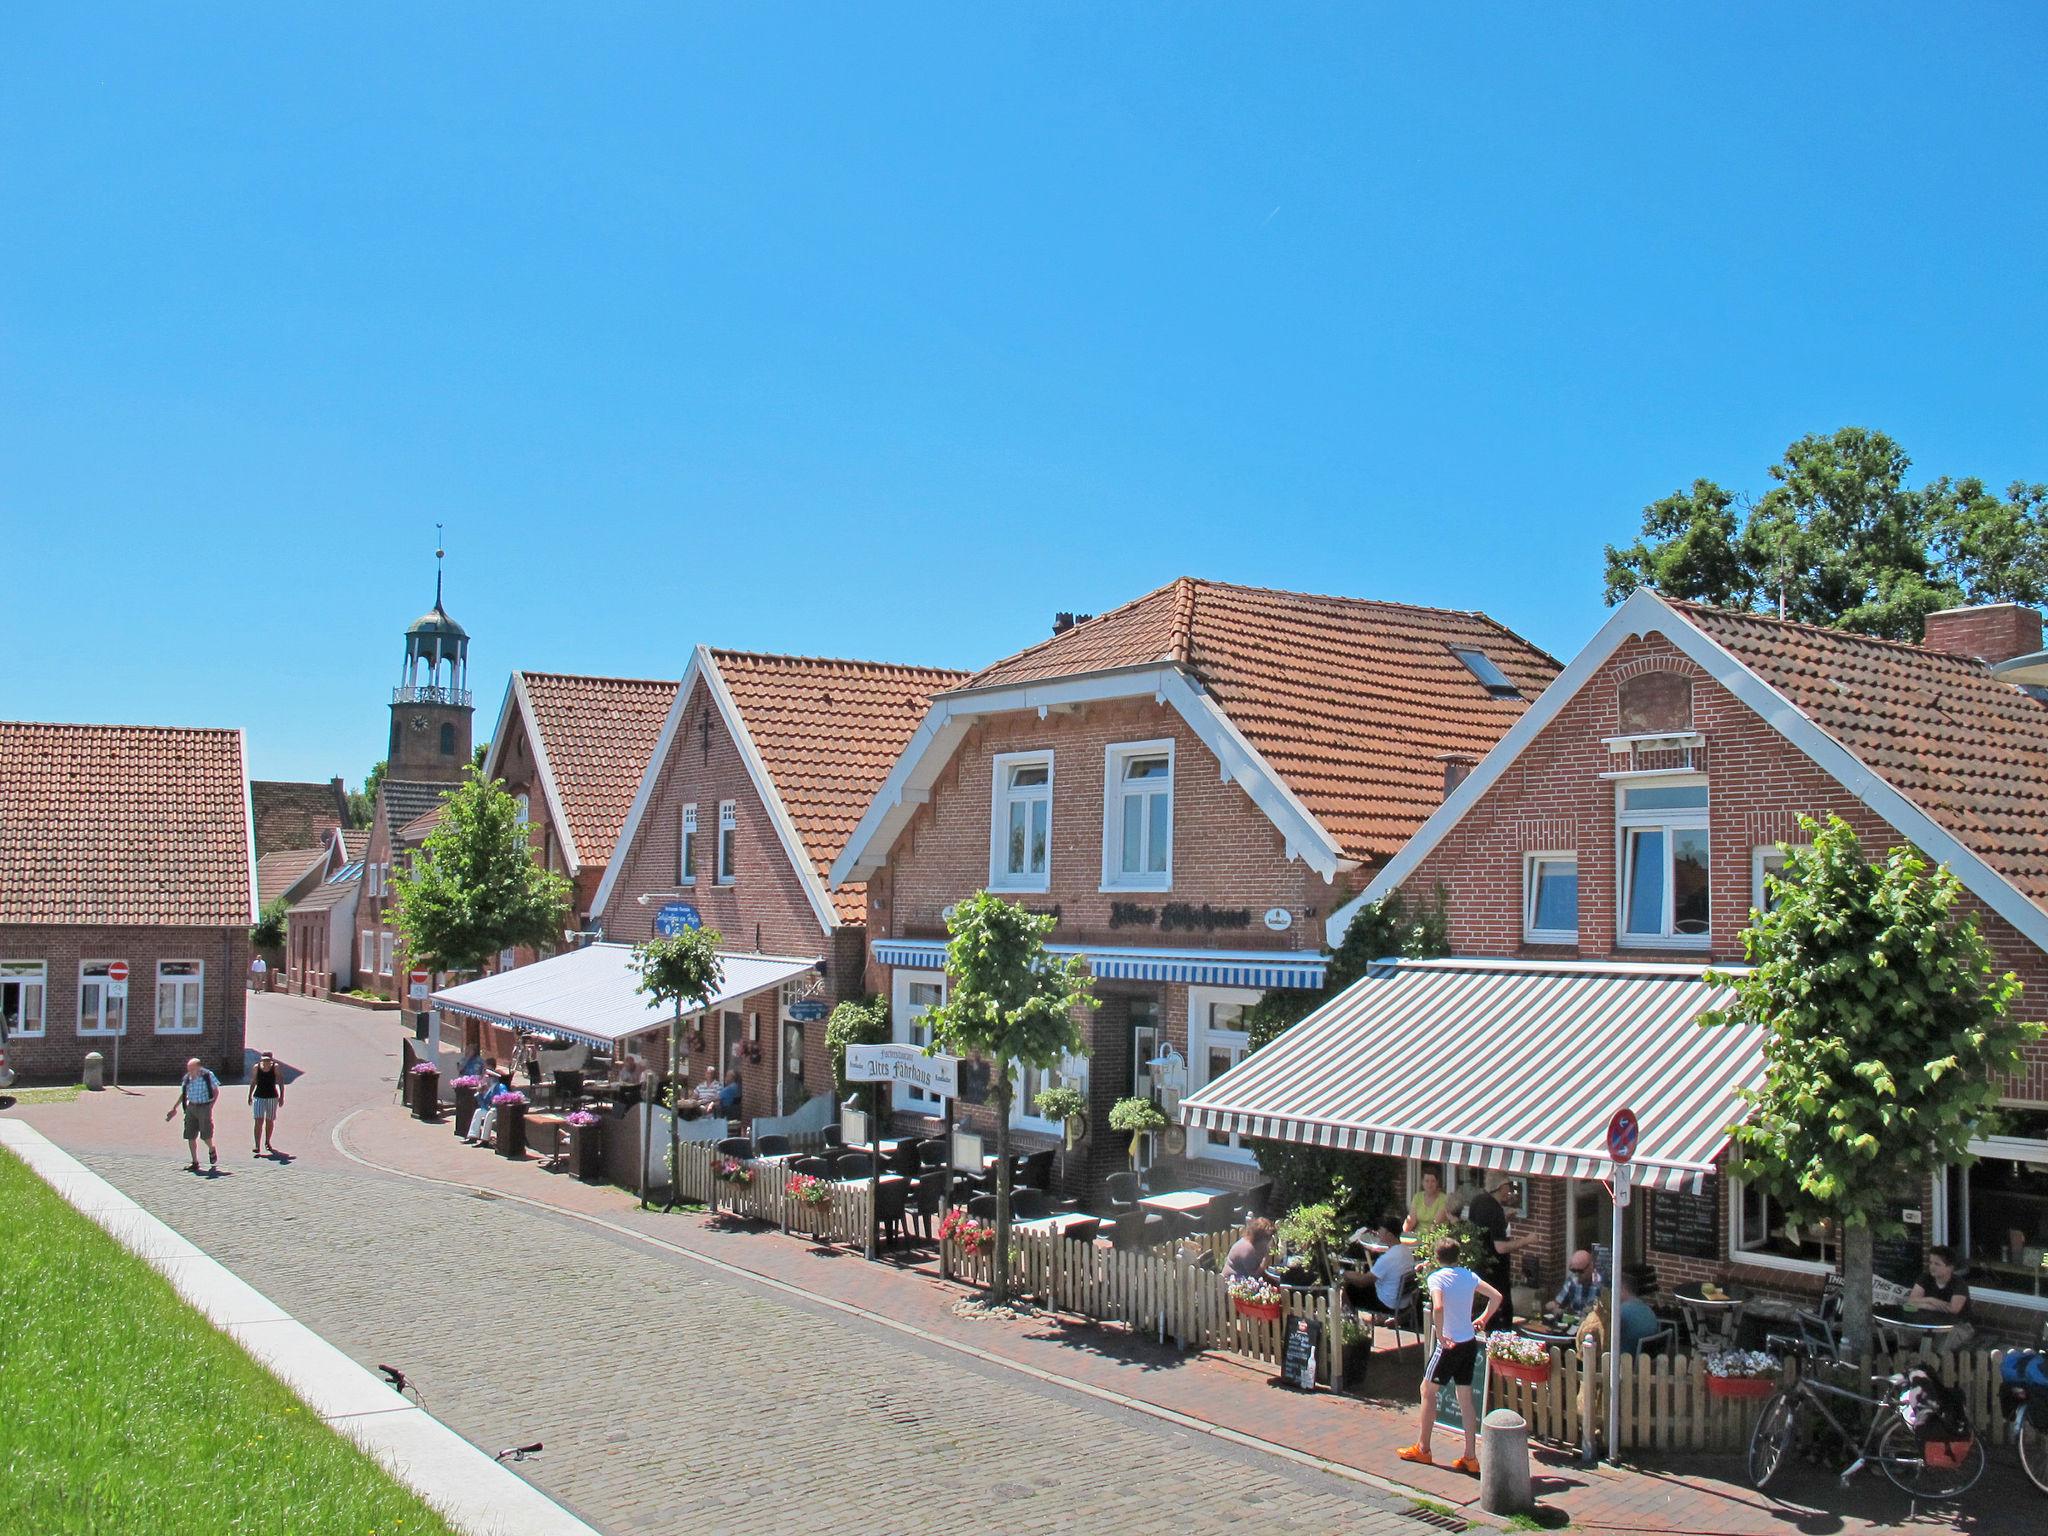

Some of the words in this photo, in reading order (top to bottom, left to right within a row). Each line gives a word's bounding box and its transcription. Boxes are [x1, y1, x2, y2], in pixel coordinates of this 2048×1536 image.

[867, 1060, 890, 1076] Altes
[892, 1060, 932, 1085] Fährhaus
[1873, 1279, 1892, 1291] THIS
[1892, 1285, 1903, 1295] IS
